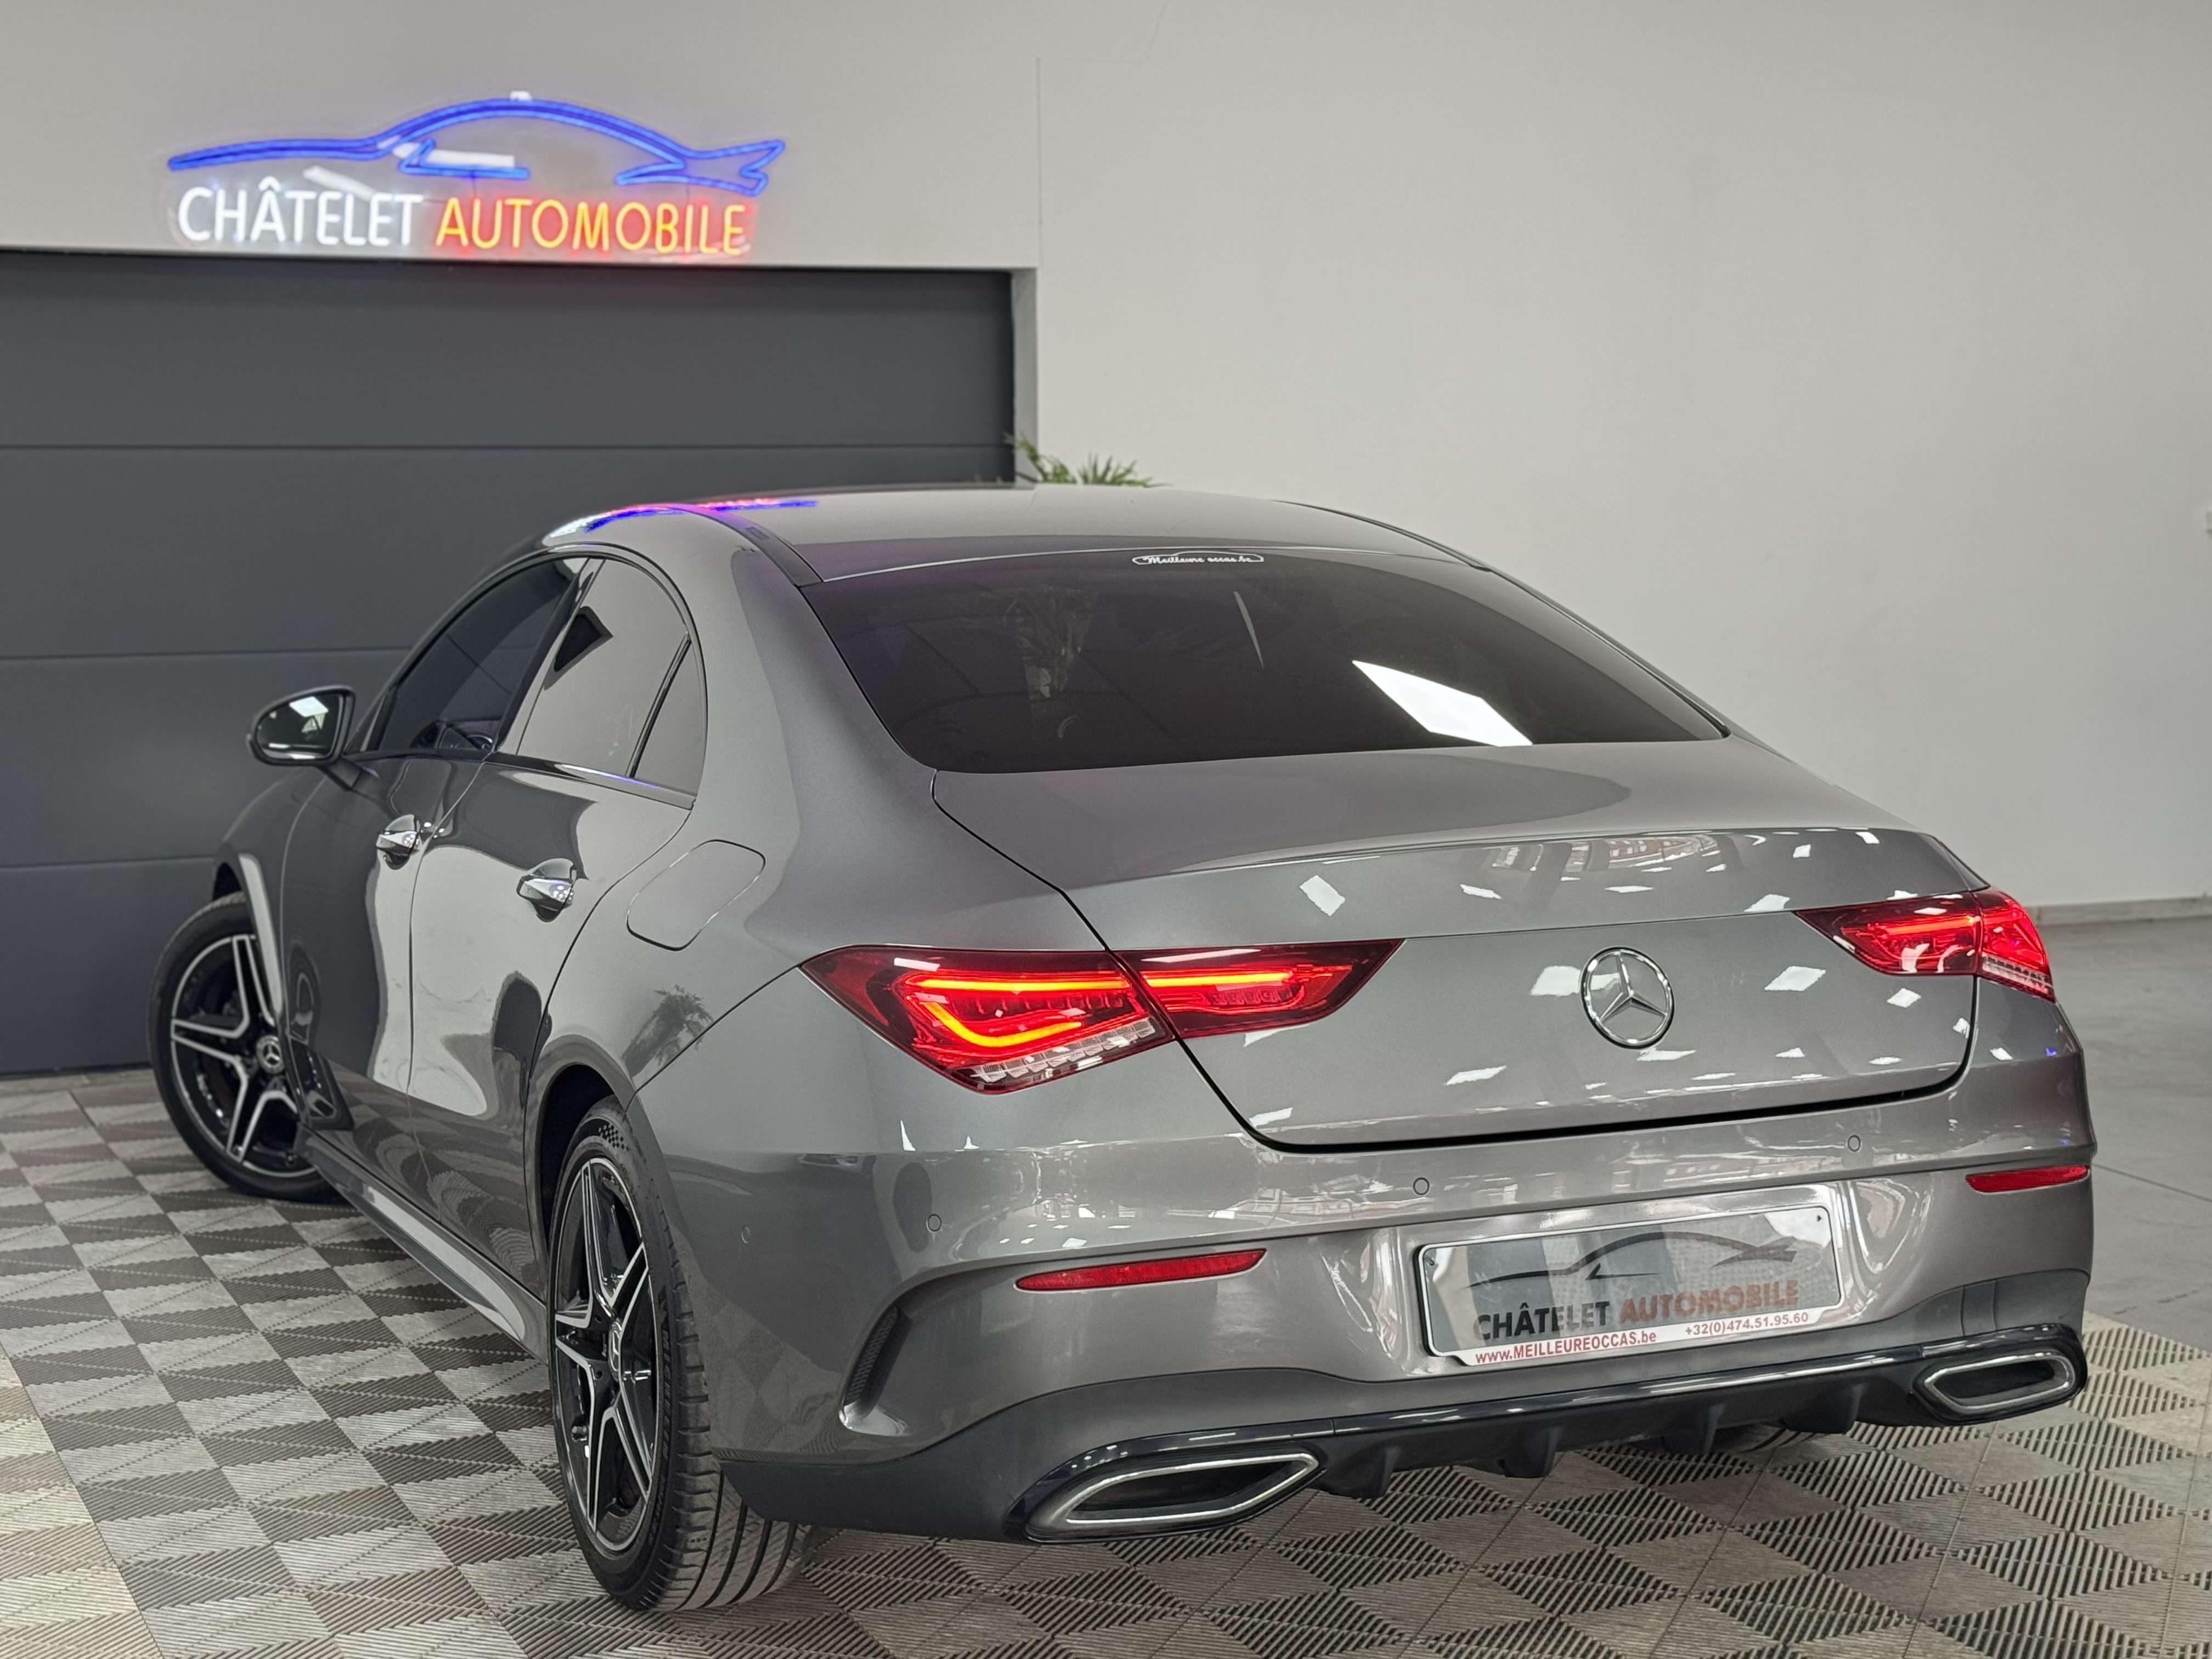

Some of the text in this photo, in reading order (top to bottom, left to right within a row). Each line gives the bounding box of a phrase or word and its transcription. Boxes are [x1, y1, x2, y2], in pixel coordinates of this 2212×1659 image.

[177, 176, 747, 256] CHÂTELET AUTOMOBILE
[1473, 1280, 1799, 1340] CHÂTELET AUTOMOBILE
[1475, 1312, 1809, 1364] www.MEILLEUREOCCAS.be +32(0)474.51.95.60
